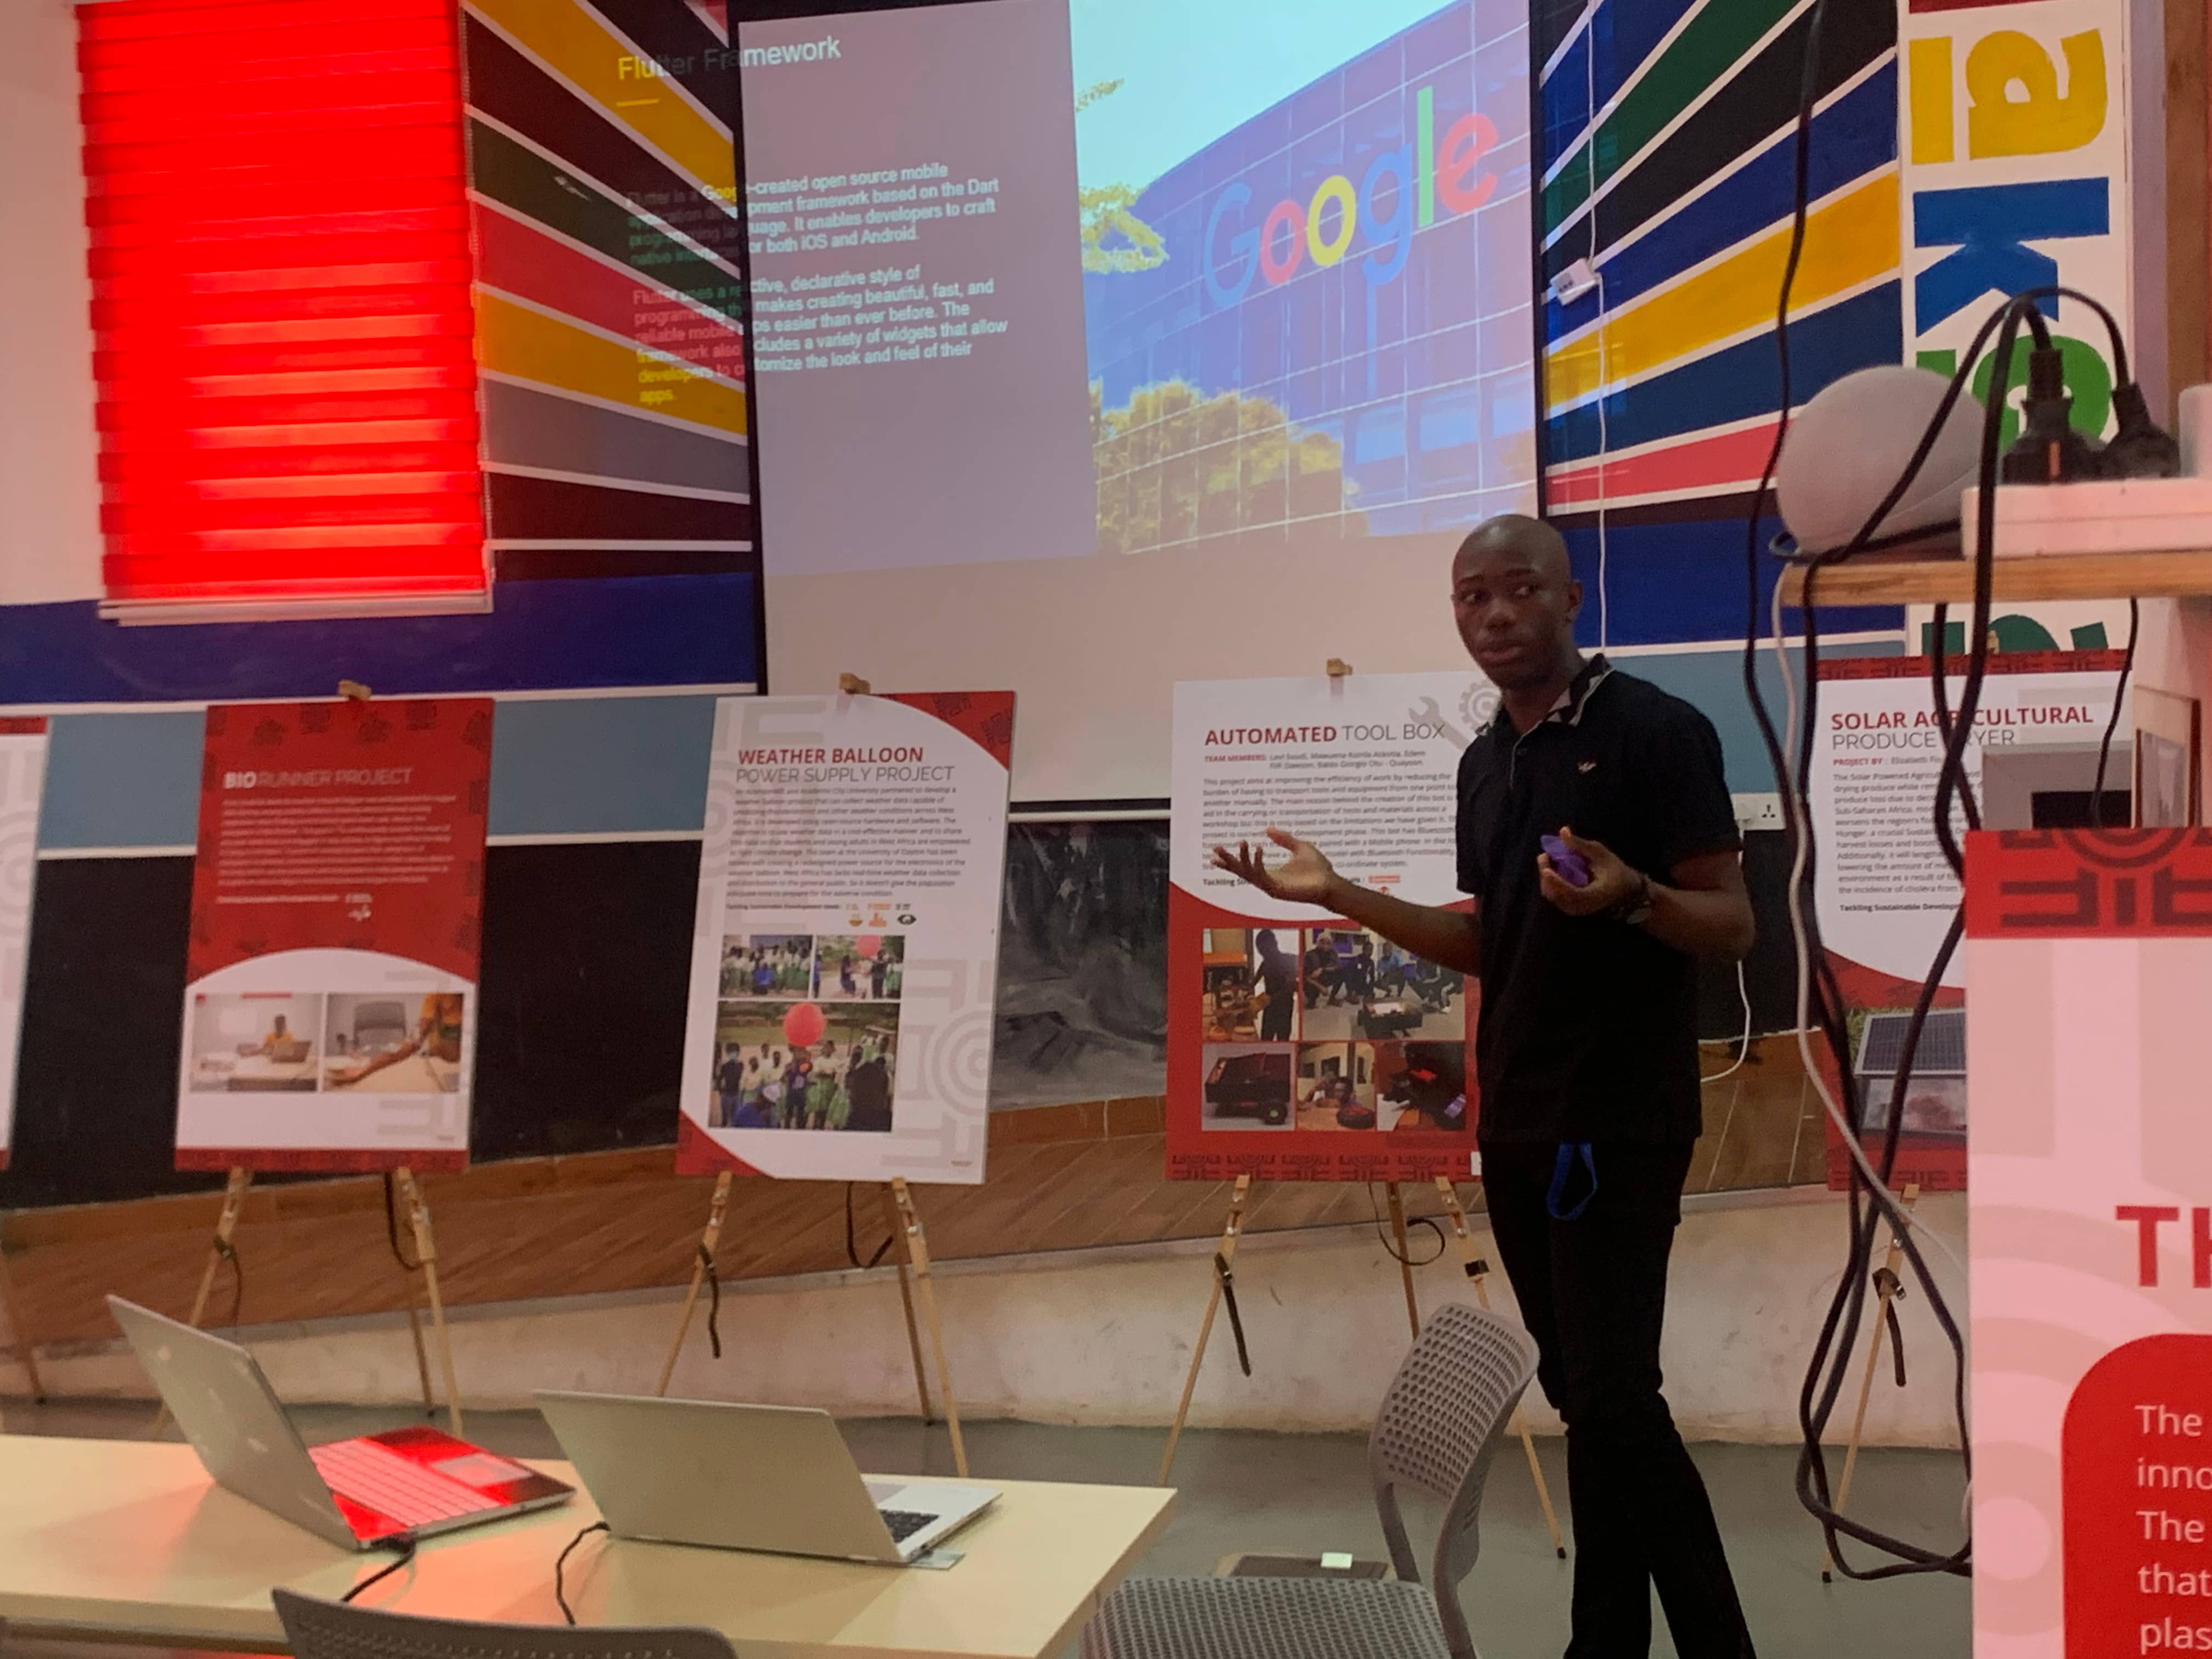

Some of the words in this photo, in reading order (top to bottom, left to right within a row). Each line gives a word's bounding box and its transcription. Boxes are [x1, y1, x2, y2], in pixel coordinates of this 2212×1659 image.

[812, 175, 846, 190] open
[850, 171, 897, 184] source
[901, 165, 948, 181] mobile
[797, 189, 869, 208] framework
[873, 185, 915, 202] based
[920, 187, 938, 198] on
[941, 182, 964, 196] the
[968, 178, 998, 194] Dart
[1203, 85, 1499, 308] Google
[795, 215, 803, 230] It
[808, 212, 861, 229] enables
[866, 207, 942, 223] developers
[946, 202, 960, 217] to
[964, 199, 996, 215] craft
[767, 235, 797, 252] both
[802, 233, 827, 249] iOS
[831, 231, 857, 246] and
[862, 226, 919, 244] Android.
[791, 271, 866, 289] declarative
[870, 268, 901, 286] style
[906, 266, 921, 280] of
[755, 296, 803, 311] makes
[807, 291, 862, 308] creating
[866, 285, 928, 303] beautiful,
[933, 282, 963, 300] fast,
[968, 280, 994, 295] and
[775, 314, 816, 330] easier
[821, 311, 851, 326] than
[855, 311, 885, 323] ever
[889, 306, 938, 321] before.
[943, 302, 970, 317] The
[713, 343, 741, 358] also
[804, 336, 813, 347] a
[817, 329, 861, 347] variety
[866, 328, 880, 342] of
[883, 324, 936, 343] widgets
[940, 321, 967, 337] that
[972, 319, 1007, 334] allow
[806, 352, 827, 366] the
[831, 349, 861, 365] look
[864, 347, 891, 363] and
[894, 345, 920, 360] feel
[924, 344, 937, 358] of
[940, 342, 972, 357] their
[1204, 726, 1337, 746] AUTOMATED
[1341, 725, 1397, 741] TOOL
[1403, 723, 1446, 741] BOX
[1831, 713, 1907, 730] SOLAR
[1832, 732, 1937, 750] PRODUCE
[738, 748, 825, 764] WEATHER
[832, 747, 924, 763] BALLOON
[736, 768, 799, 783] POWER
[804, 767, 872, 782] SUPPLY
[876, 766, 955, 781] PROJECT
[1839, 903, 1873, 912] Tackling
[2135, 1404, 2203, 1437] The
[2137, 1457, 2212, 1491] inno
[2136, 1510, 2205, 1543] The
[2137, 1563, 2212, 1597] that
[2140, 1616, 2212, 1655] plas
